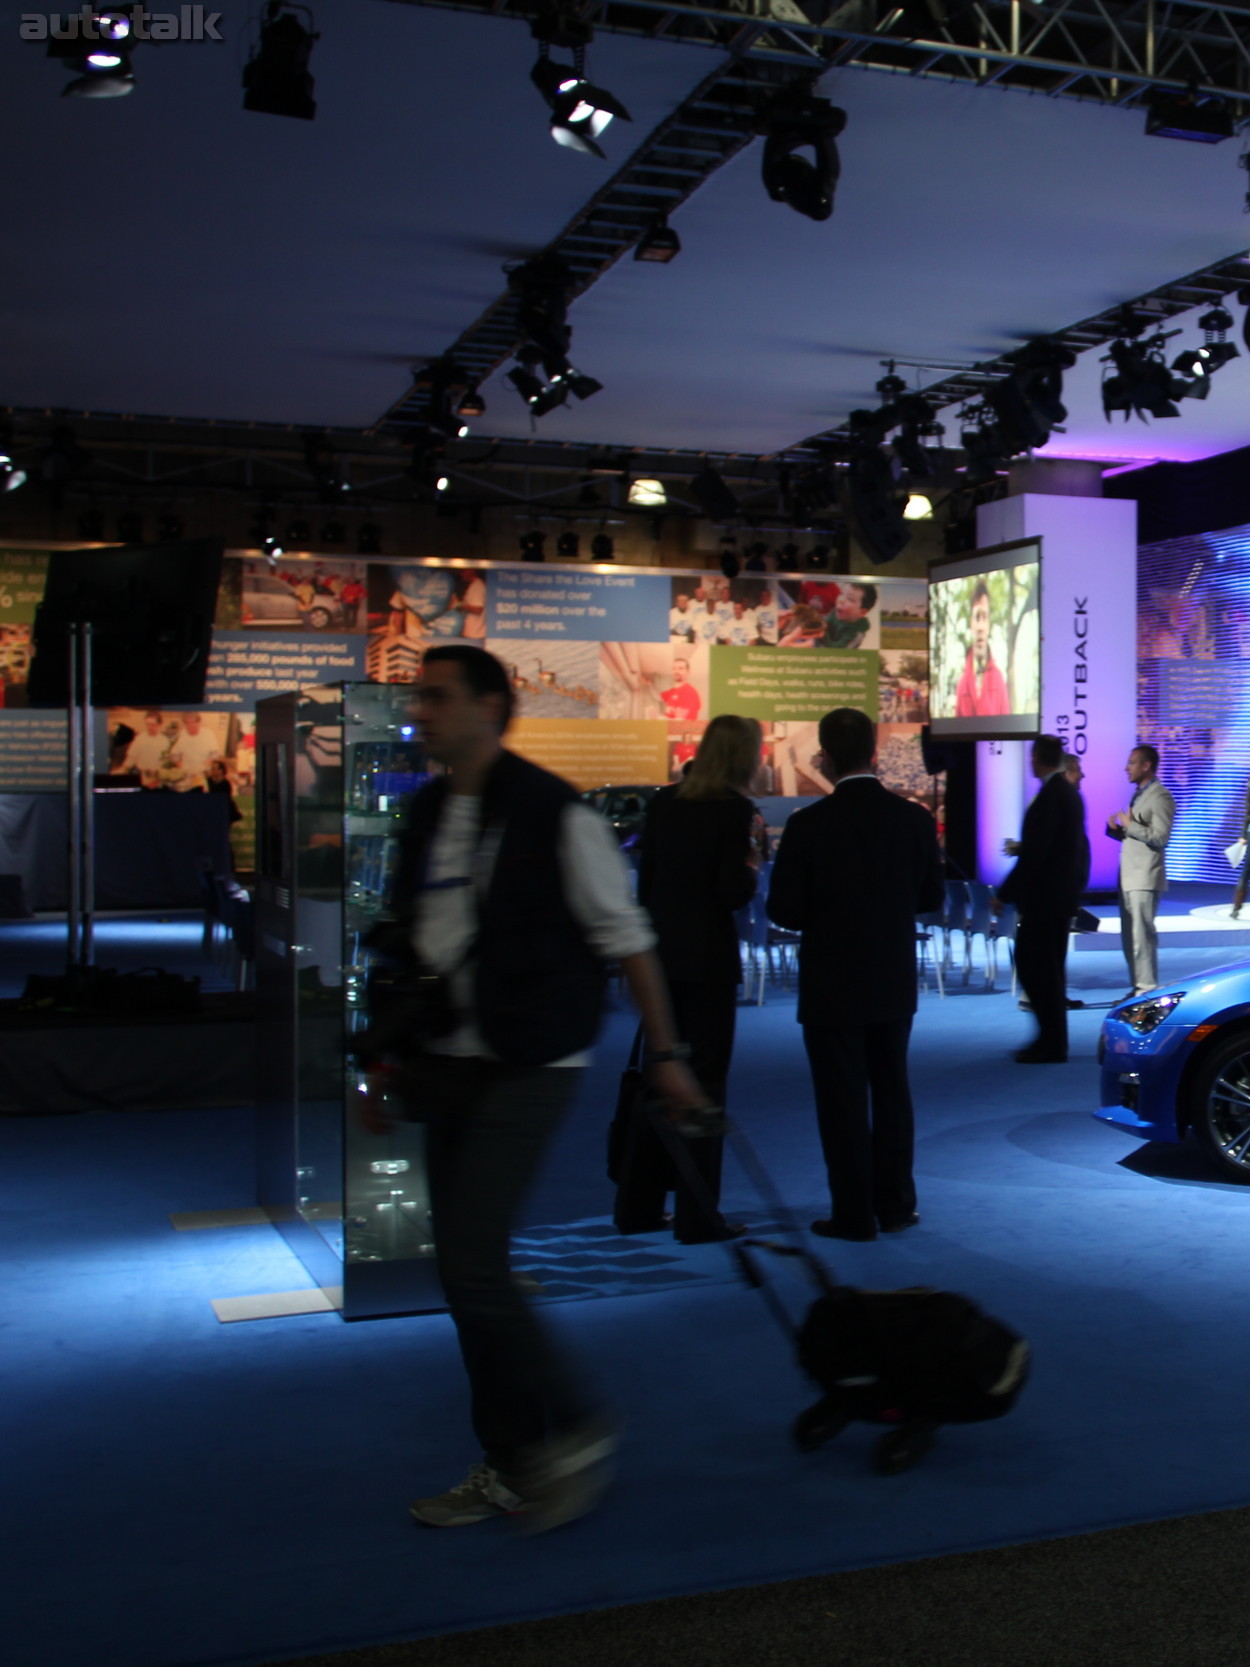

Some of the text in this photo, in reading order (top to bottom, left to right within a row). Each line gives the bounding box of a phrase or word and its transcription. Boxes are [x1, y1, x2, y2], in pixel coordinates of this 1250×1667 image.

[575, 574, 602, 586] Love
[605, 575, 636, 587] Event
[496, 588, 592, 601] has donated over
[520, 603, 560, 616] million
[562, 606, 586, 616] over
[588, 605, 607, 617] the
[496, 619, 521, 631] past
[523, 620, 532, 630] 4
[301, 642, 347, 653] provided
[271, 654, 314, 666] pounds
[315, 655, 327, 665] of
[328, 656, 355, 667] food
[225, 667, 273, 678] produce
[1073, 596, 1088, 755] OUTBACK
[1056, 714, 1070, 753] 013
